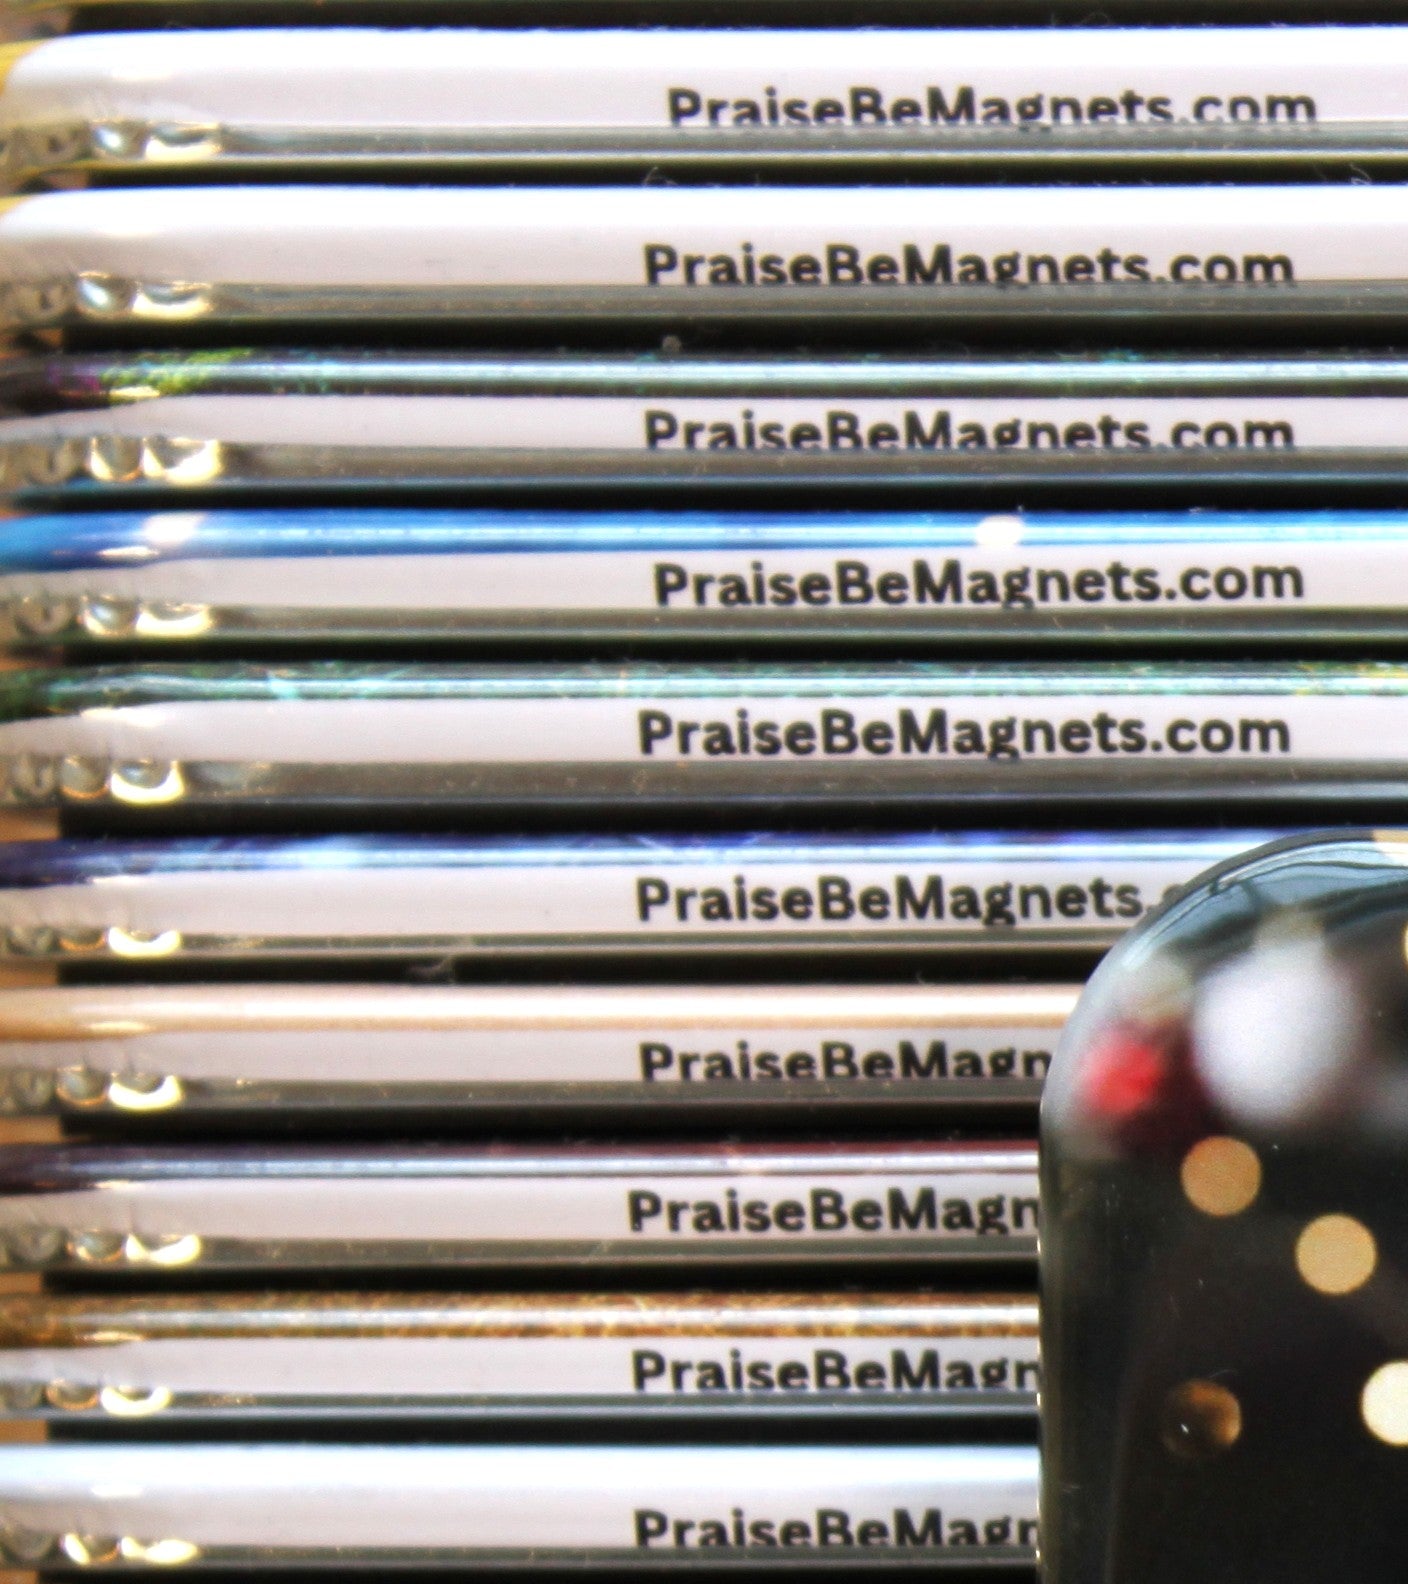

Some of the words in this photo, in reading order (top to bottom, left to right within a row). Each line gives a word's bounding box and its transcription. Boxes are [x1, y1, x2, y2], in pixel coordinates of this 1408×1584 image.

[643, 243, 1295, 286] PraiseBeMagnets.com
[653, 559, 1304, 609] PraiseBeMagnets.com
[638, 708, 1291, 761] PraiseBeMagnets.com
[636, 876, 1162, 926] PraiseBeMagnets.
[641, 1041, 1051, 1080] PraiseBeMagn
[630, 1189, 1039, 1236] PraiseBeMagn
[631, 1349, 1039, 1392] PraiseBeMagn
[633, 1509, 1038, 1547] PraiseBeMagn
